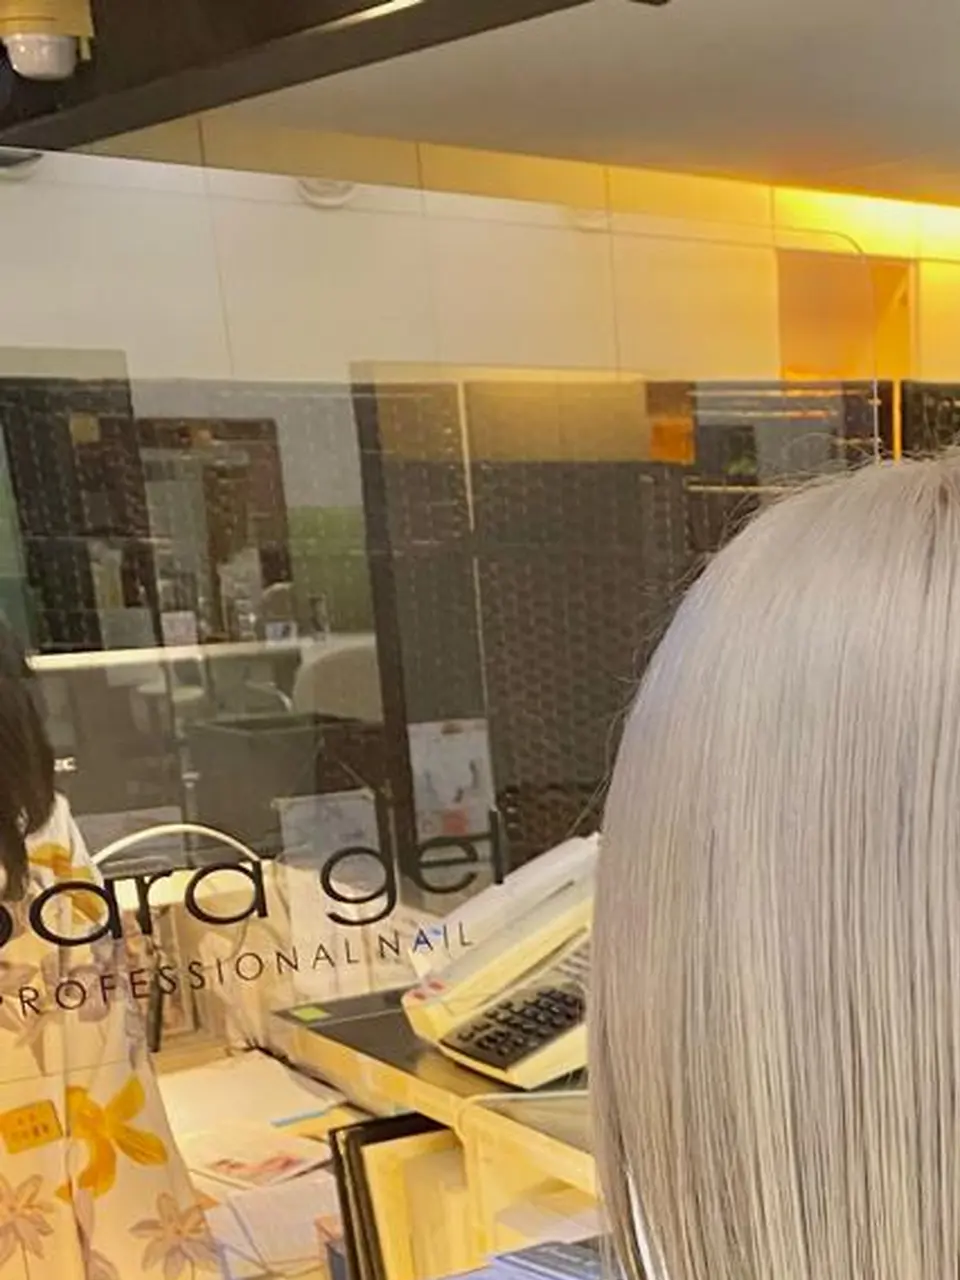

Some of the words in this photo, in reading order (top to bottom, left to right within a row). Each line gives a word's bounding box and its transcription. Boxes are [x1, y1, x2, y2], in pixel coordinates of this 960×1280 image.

[0, 860, 269, 948] ara
[320, 807, 504, 927] gel
[0, 938, 361, 1017] ROFESSIONAL
